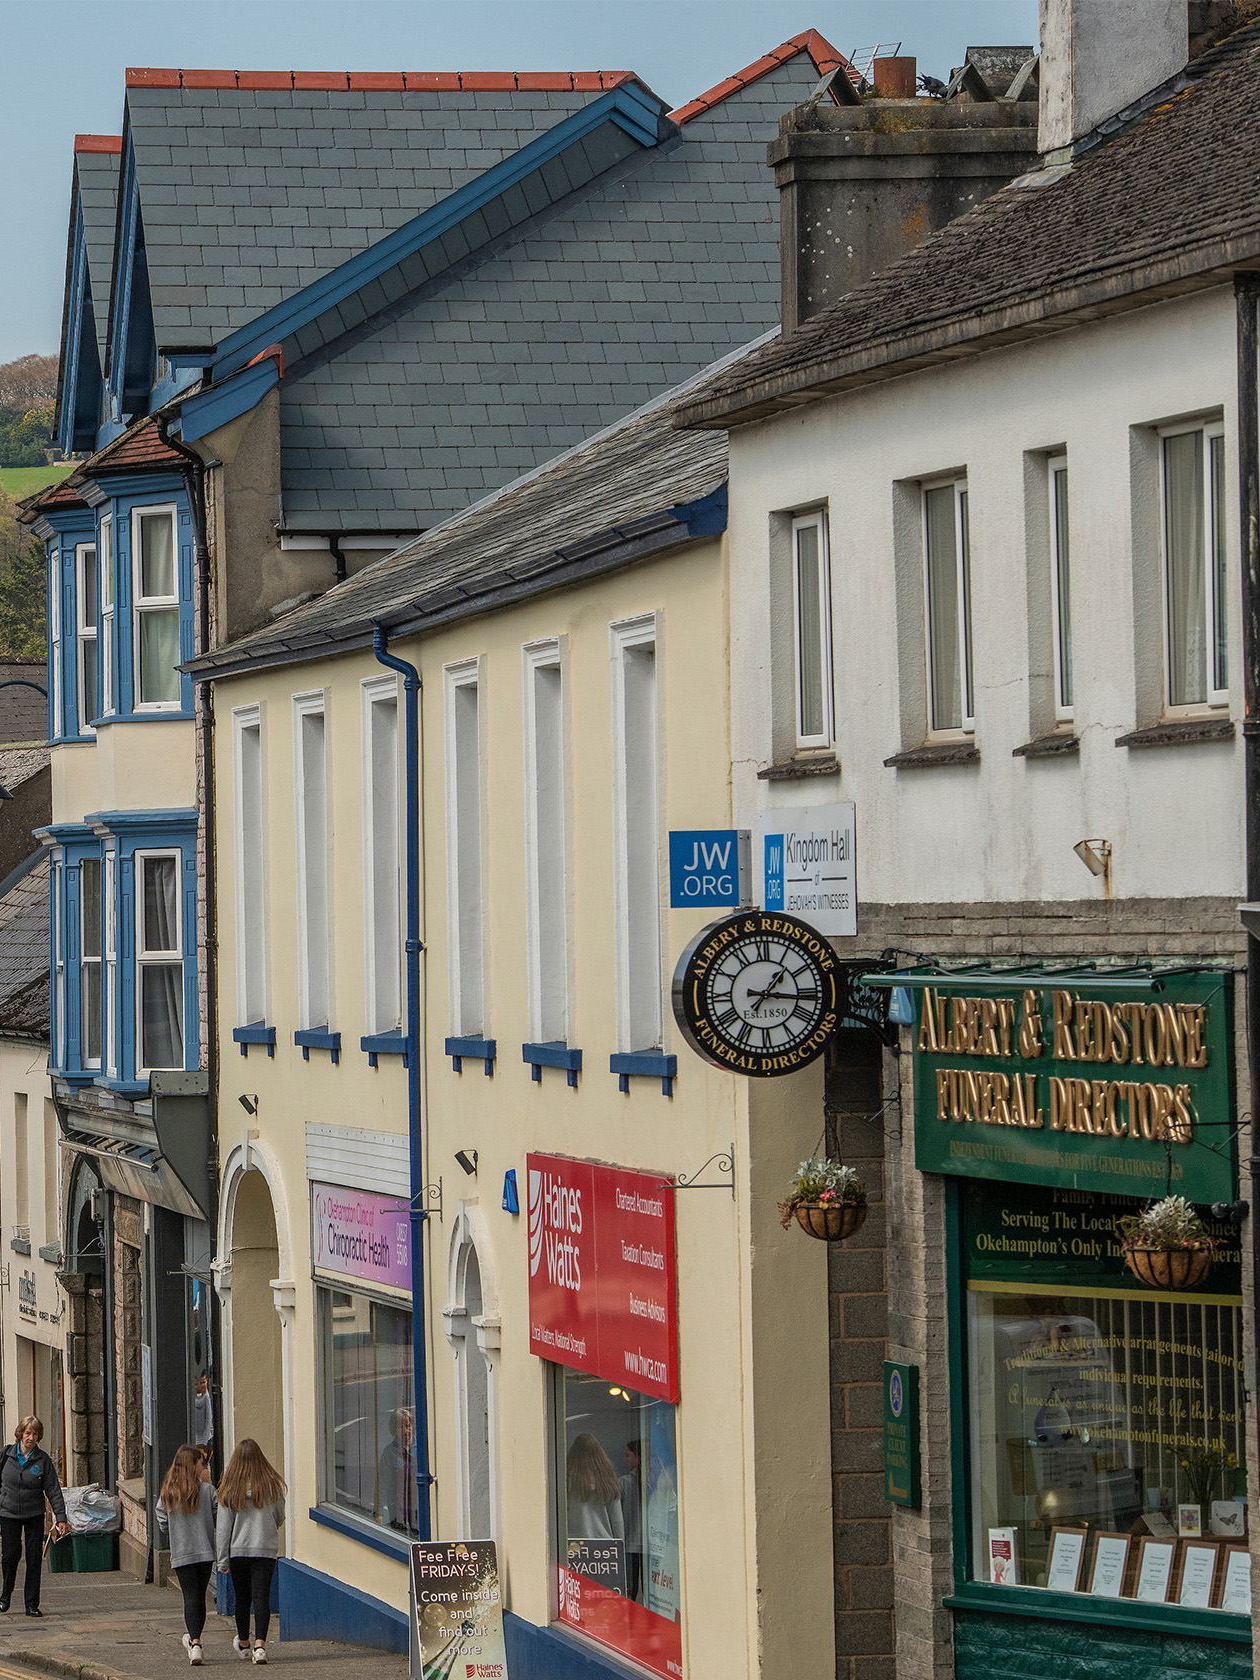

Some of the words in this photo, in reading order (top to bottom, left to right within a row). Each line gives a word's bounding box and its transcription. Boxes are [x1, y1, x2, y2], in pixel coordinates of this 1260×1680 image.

[683, 841, 732, 871] JW
[768, 846, 781, 874] JW
[786, 832, 829, 872] Kingdom
[831, 829, 850, 861] Hall
[680, 875, 733, 896] .ORG
[767, 879, 781, 899] .ORG
[814, 871, 820, 886] of
[786, 894, 817, 911] JEHOVAH'S
[818, 893, 850, 910] WITNESSES
[694, 925, 740, 980] ALBERY
[743, 920, 756, 933] &
[761, 918, 835, 972] REDSTONE
[695, 1018, 757, 1070] FUNERAL
[761, 1012, 837, 1071] DIRECTORS
[918, 987, 1015, 1056] ALBERY
[1020, 989, 1042, 1059] &
[1051, 990, 1207, 1068] REDSTONE
[935, 1069, 1043, 1128] FUNERAL
[1048, 1076, 1193, 1143] DIRECTORS
[327, 1197, 356, 1227] Okehampton
[544, 1172, 583, 1235] Haines
[616, 1188, 636, 1212] Chartered
[636, 1192, 663, 1218] Accountants
[1001, 1209, 1050, 1232] Serving
[1052, 1211, 1078, 1230] The
[1080, 1212, 1117, 1232] Local
[327, 1222, 368, 1266] Chiropractic
[369, 1232, 390, 1268] Health
[621, 1240, 639, 1264] Taxation
[639, 1244, 665, 1270] Consultants
[1071, 1237, 1103, 1260] Only
[545, 1230, 581, 1291] Watts
[629, 1292, 648, 1318] Business
[647, 1298, 666, 1323] Advisors
[532, 1322, 541, 1341] Local
[554, 1330, 571, 1351] National
[624, 1346, 668, 1384] www.hwca.com
[1060, 1337, 1069, 1352] &
[1073, 1334, 1127, 1350] Alternative
[1130, 1337, 1202, 1358] arrangements
[1204, 1347, 1245, 1372] tailored
[1079, 1368, 1130, 1383] individual
[1132, 1373, 1204, 1390] requirements.
[1022, 1388, 1060, 1412] funeral
[1075, 1399, 1088, 1410] as
[1091, 1398, 1128, 1415] unique
[1131, 1402, 1143, 1415] as
[1148, 1395, 1166, 1418] the
[1168, 1396, 1188, 1426] life
[1189, 1399, 1215, 1422] that
[419, 1550, 443, 1563] Fee
[447, 1549, 478, 1562] Free
[420, 1563, 479, 1578] FRIDAYS!
[421, 1590, 458, 1603] Come
[462, 1589, 499, 1601] inside
[565, 1571, 581, 1600] Haines
[450, 1607, 473, 1619] and
[565, 1593, 580, 1621] Watts
[439, 1625, 463, 1638] find
[466, 1625, 488, 1637] out
[448, 1646, 482, 1656] more
[476, 1663, 503, 1671] Haines
[477, 1670, 502, 1678] Watts
